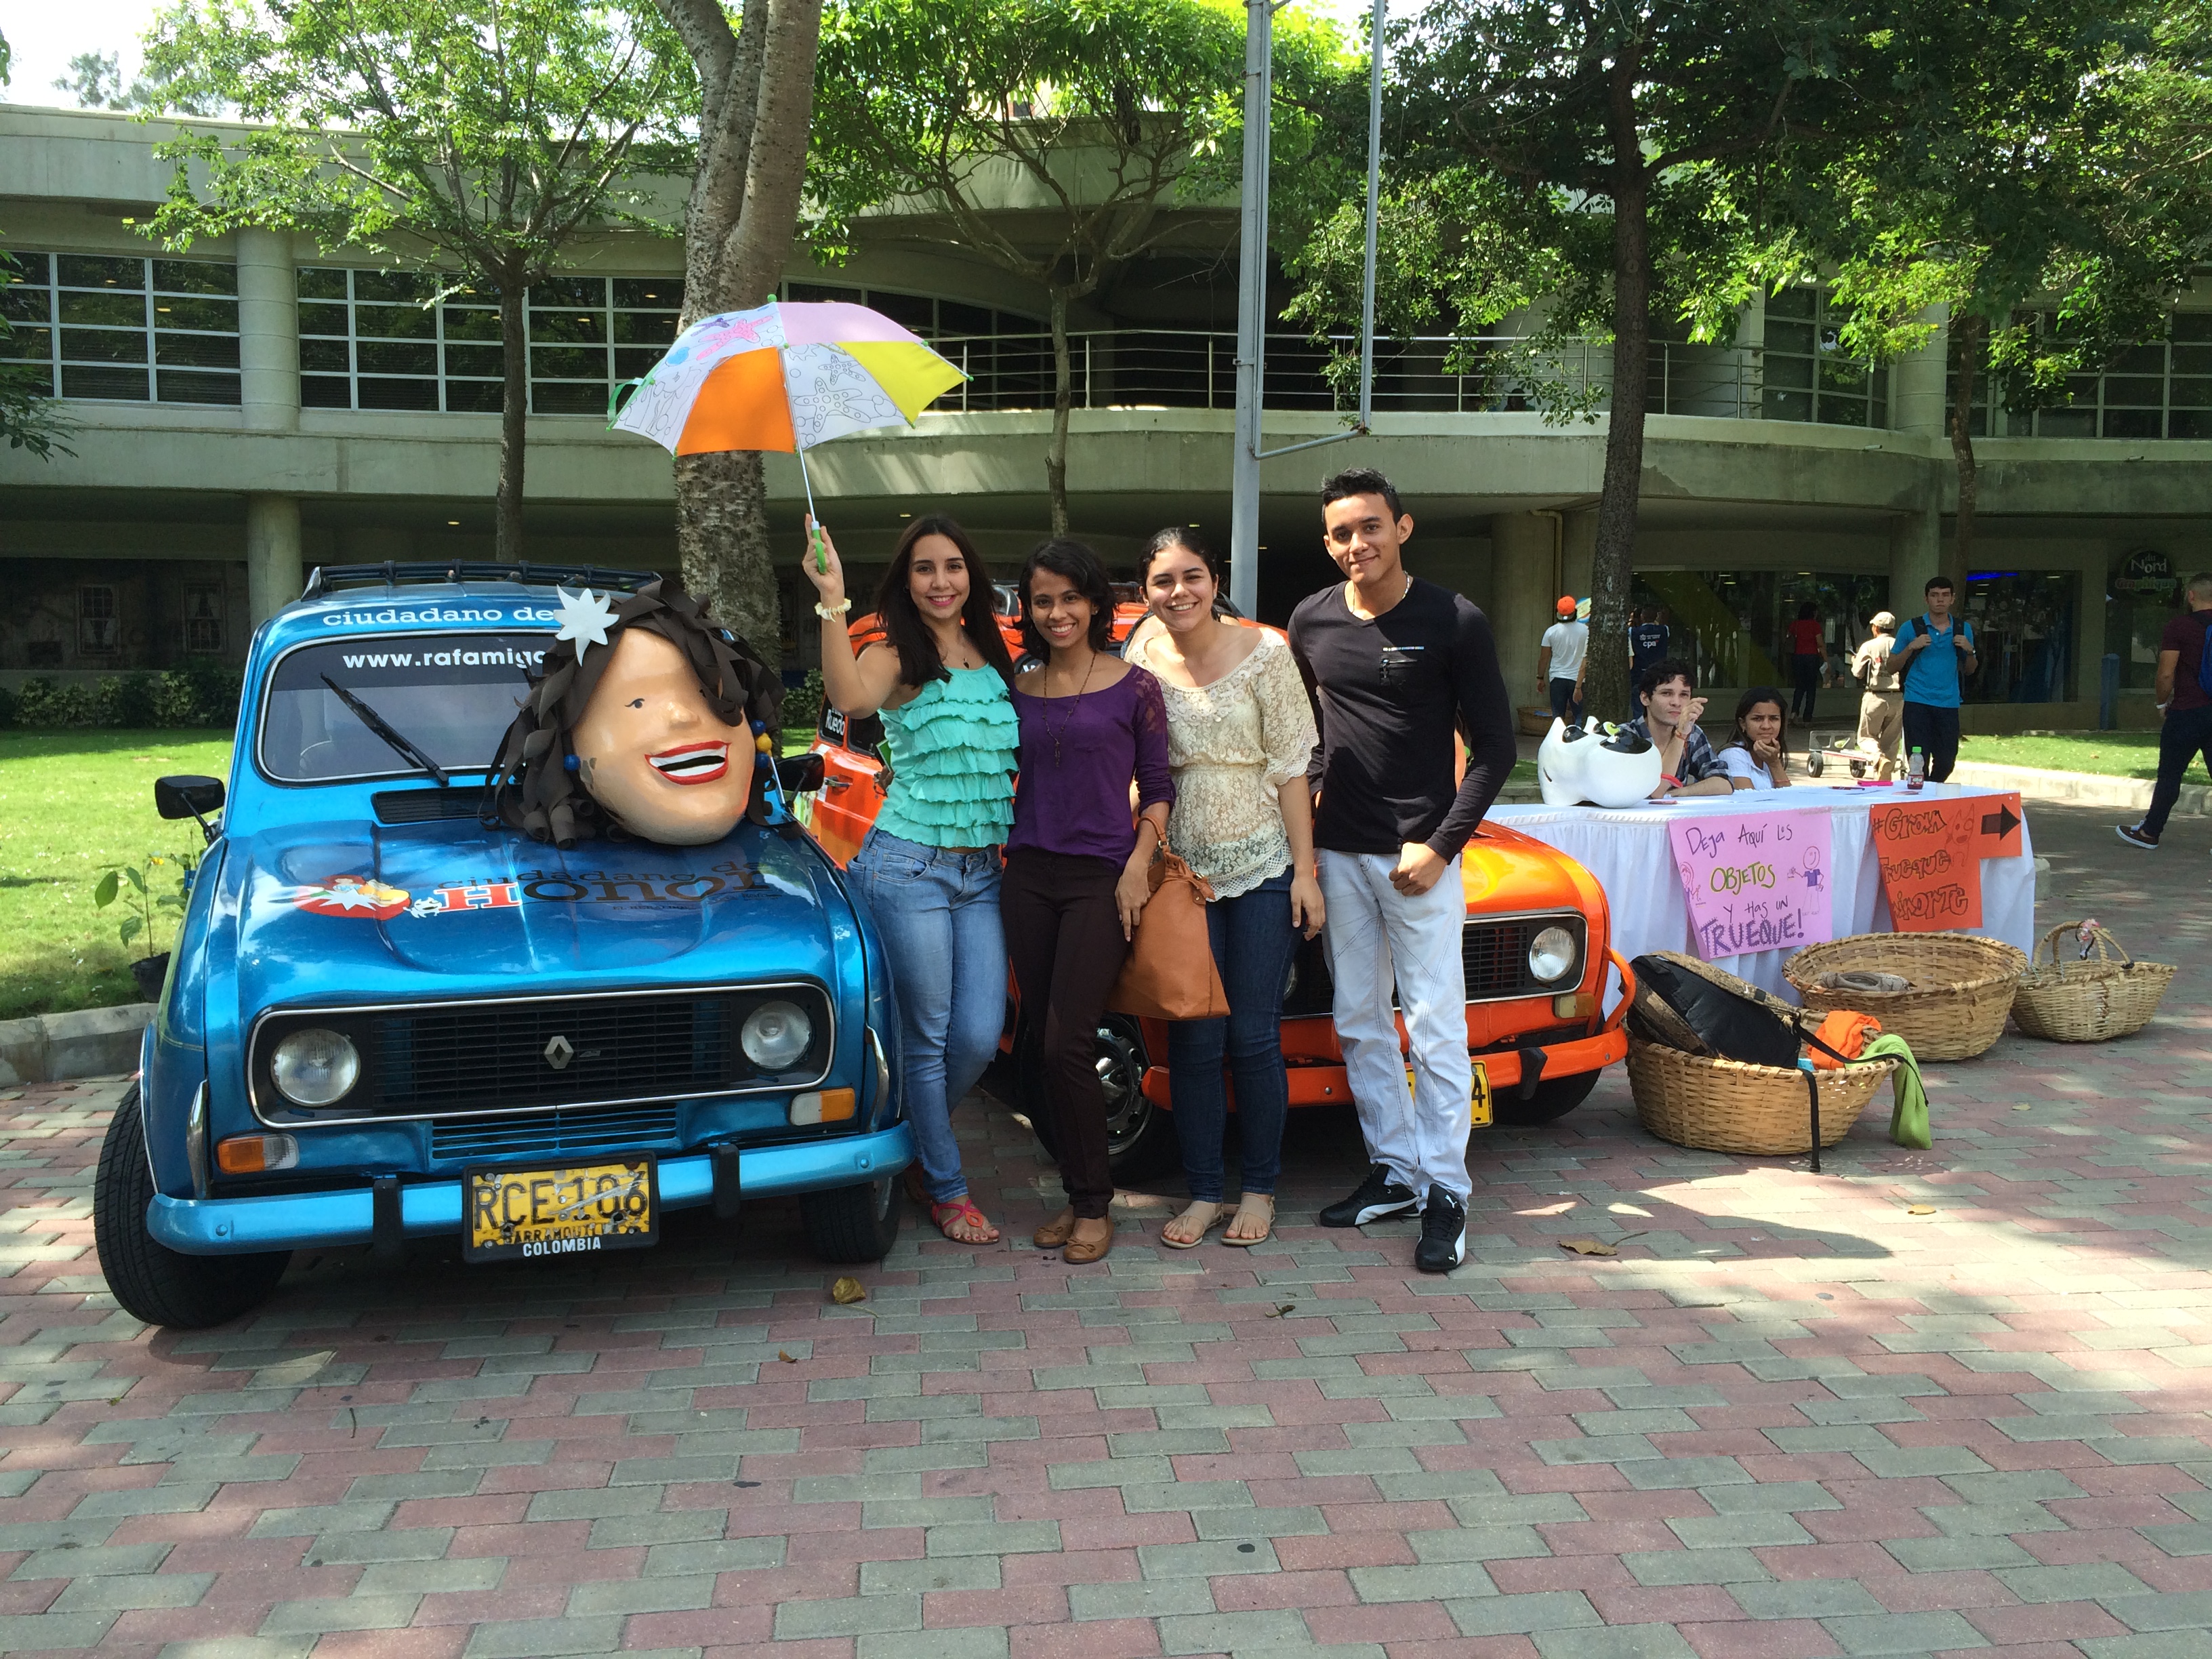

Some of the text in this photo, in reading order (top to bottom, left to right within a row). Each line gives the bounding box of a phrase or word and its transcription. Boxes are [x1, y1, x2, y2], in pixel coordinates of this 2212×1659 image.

[2131, 558, 2167, 573] Nord
[2145, 553, 2156, 562] du
[323, 607, 554, 627] ciudadano de
[438, 870, 696, 889] ciudadano
[1711, 861, 1776, 895] OBJETOS
[434, 870, 771, 913] Honor
[1723, 903, 1733, 923] Y
[1700, 908, 1804, 956] TRUEQUE!
[523, 1237, 601, 1257] COLOMBIA
